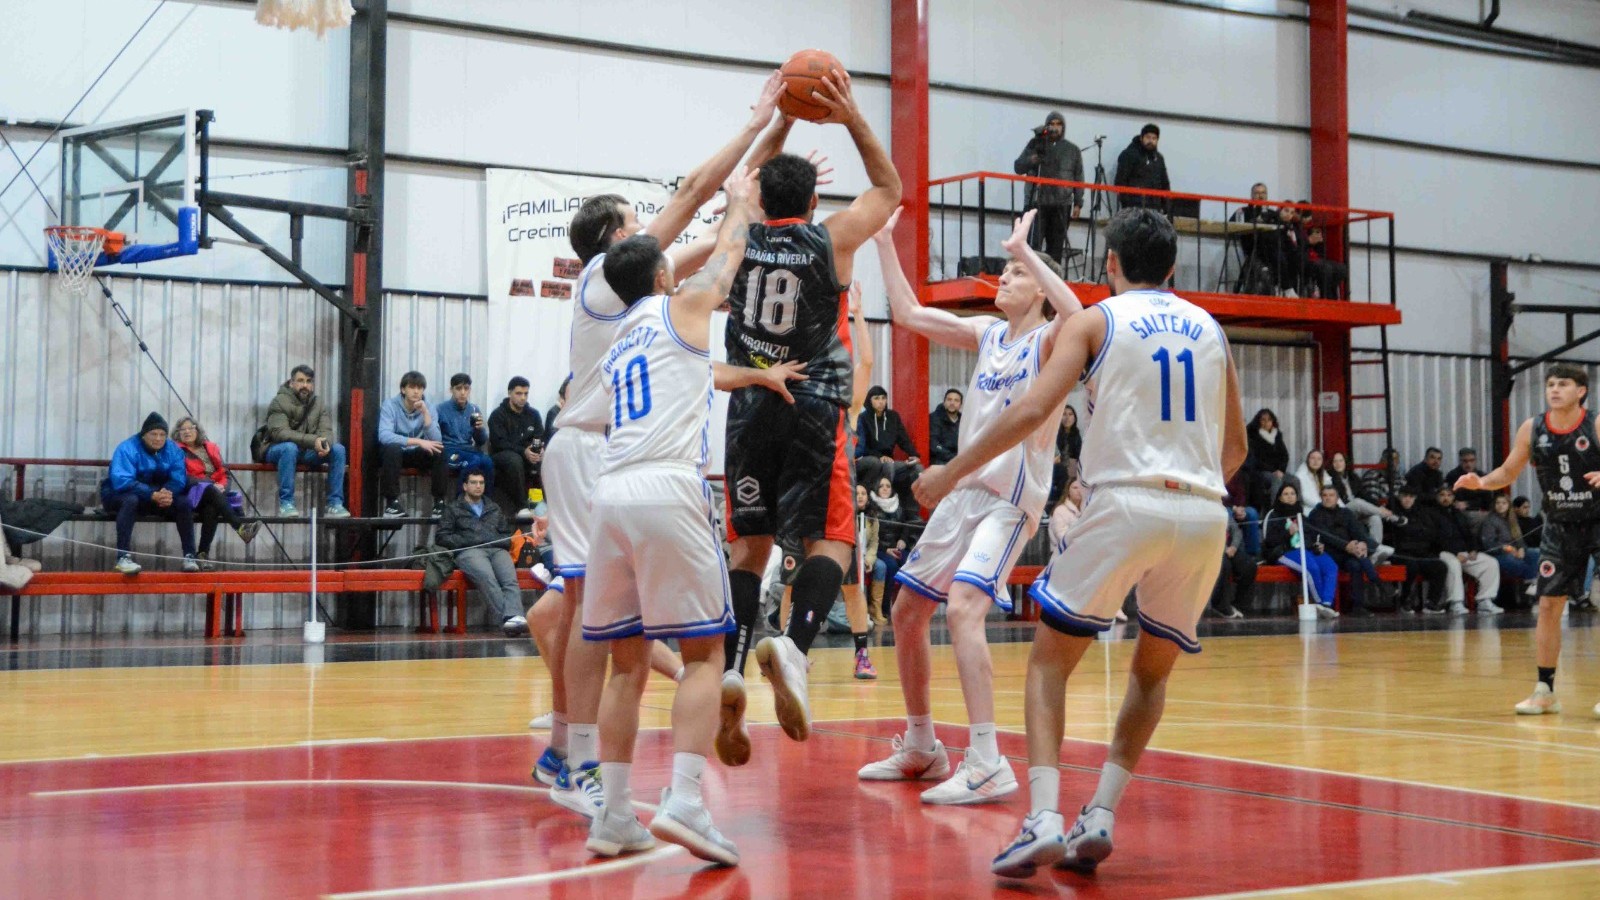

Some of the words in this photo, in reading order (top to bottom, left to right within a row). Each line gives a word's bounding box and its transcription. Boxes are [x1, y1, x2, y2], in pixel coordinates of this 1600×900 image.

[508, 221, 570, 242] Crecimi
[745, 247, 775, 263] ABAÑAS
[776, 252, 807, 265] RIVERA
[809, 253, 815, 265] F
[743, 265, 802, 336] 18
[1129, 313, 1203, 341] SALTEÑO
[740, 333, 790, 360] URQUIZA
[612, 354, 653, 429] 10
[1151, 346, 1196, 421] 11
[1567, 488, 1593, 501] Juan
